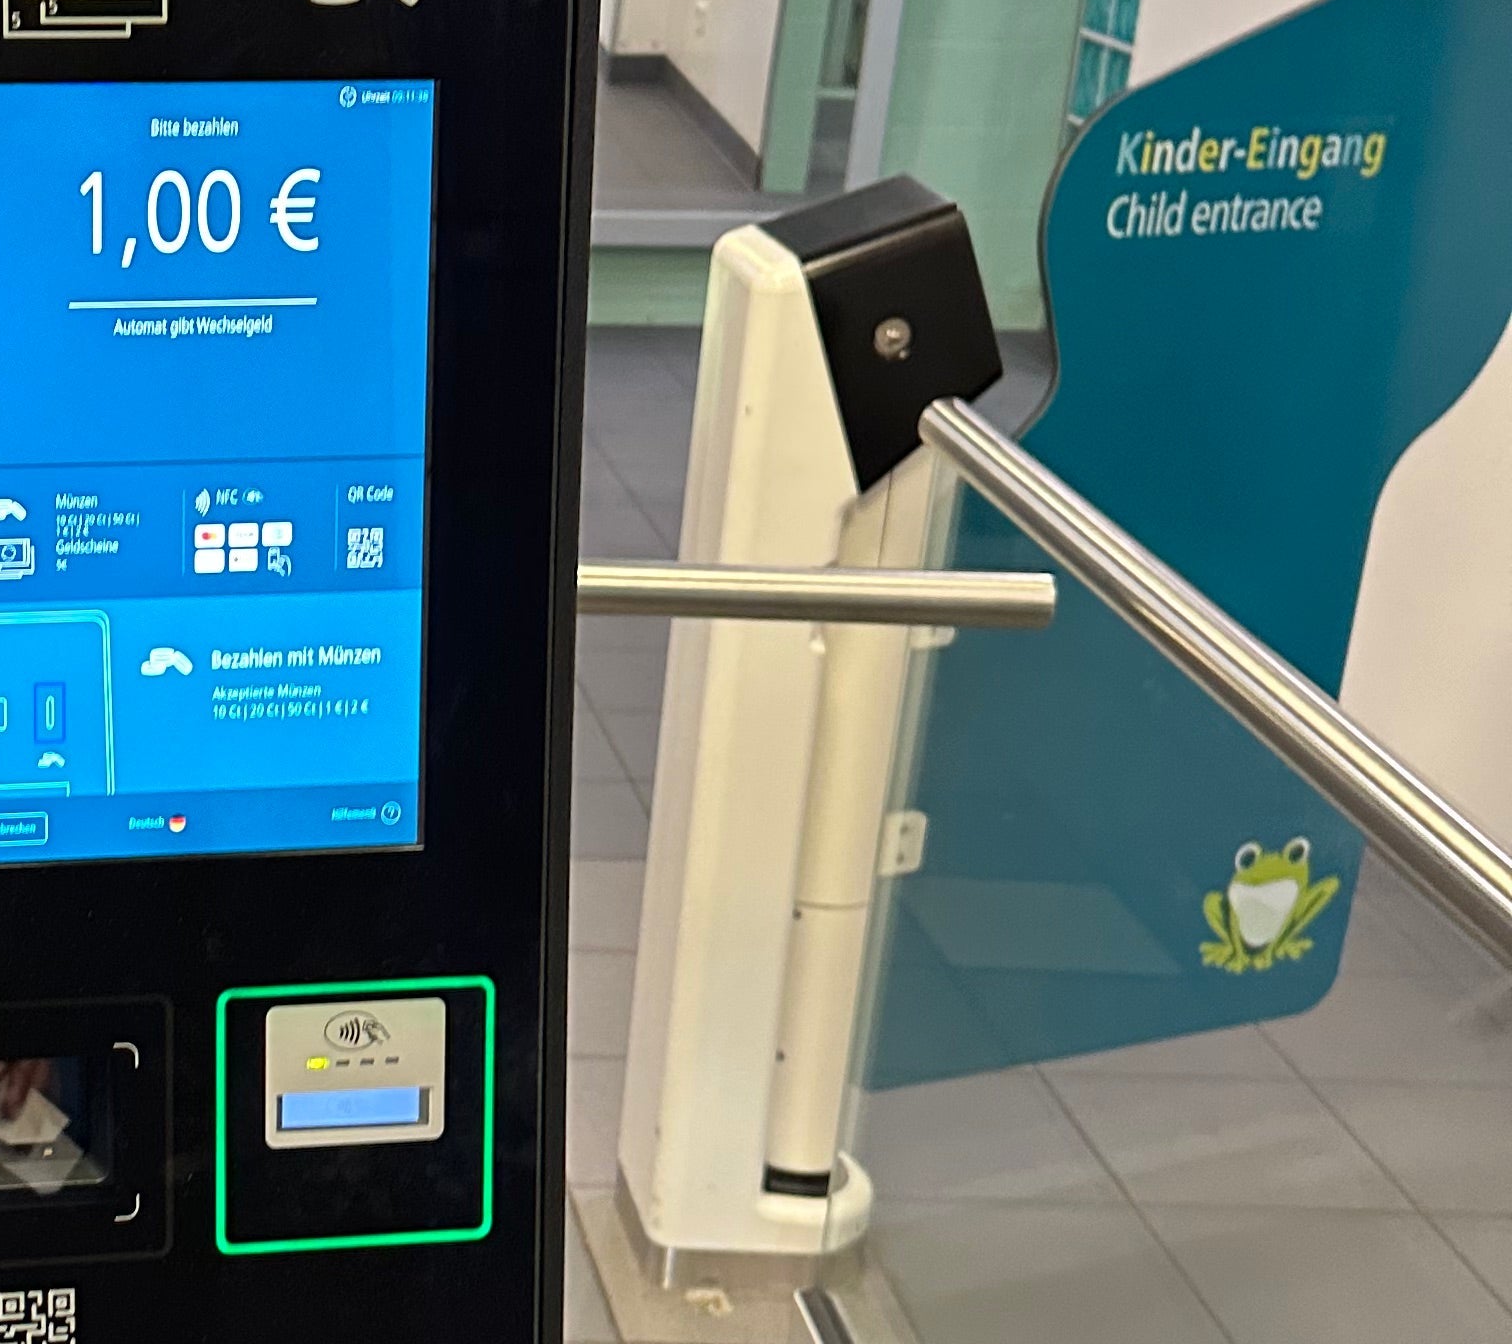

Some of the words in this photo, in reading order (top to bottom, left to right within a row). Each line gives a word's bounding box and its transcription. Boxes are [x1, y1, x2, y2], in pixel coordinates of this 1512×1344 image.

[151, 118, 180, 137] Bitte
[183, 116, 238, 136] bezahlen
[1116, 126, 1386, 180] Kinder-Eingang
[80, 169, 241, 268] 1,00
[269, 168, 321, 252] €
[1106, 190, 1186, 239] Child
[1191, 194, 1323, 235] entrance
[113, 318, 167, 336] Automat
[170, 316, 195, 338] gibt
[196, 314, 272, 337] Wechselgeld
[56, 493, 98, 510] Münzen
[216, 488, 238, 506] NFC
[348, 486, 364, 504] QR
[367, 485, 394, 502] Code
[56, 538, 118, 555] Geldscheine
[212, 647, 282, 670] Bezahlen
[287, 646, 314, 667] mit
[318, 645, 381, 666] Münzen
[212, 685, 274, 702] Akzeptierte
[278, 684, 321, 700] Münzen
[213, 705, 227, 720] 10
[228, 704, 241, 720] Ct
[250, 703, 264, 718] 20
[266, 703, 278, 718] Ct
[288, 702, 302, 717] 50
[304, 701, 316, 716] Ct
[334, 700, 342, 715] €
[351, 699, 358, 715] 2
[361, 699, 369, 714] €
[128, 816, 164, 830] Deutsch
